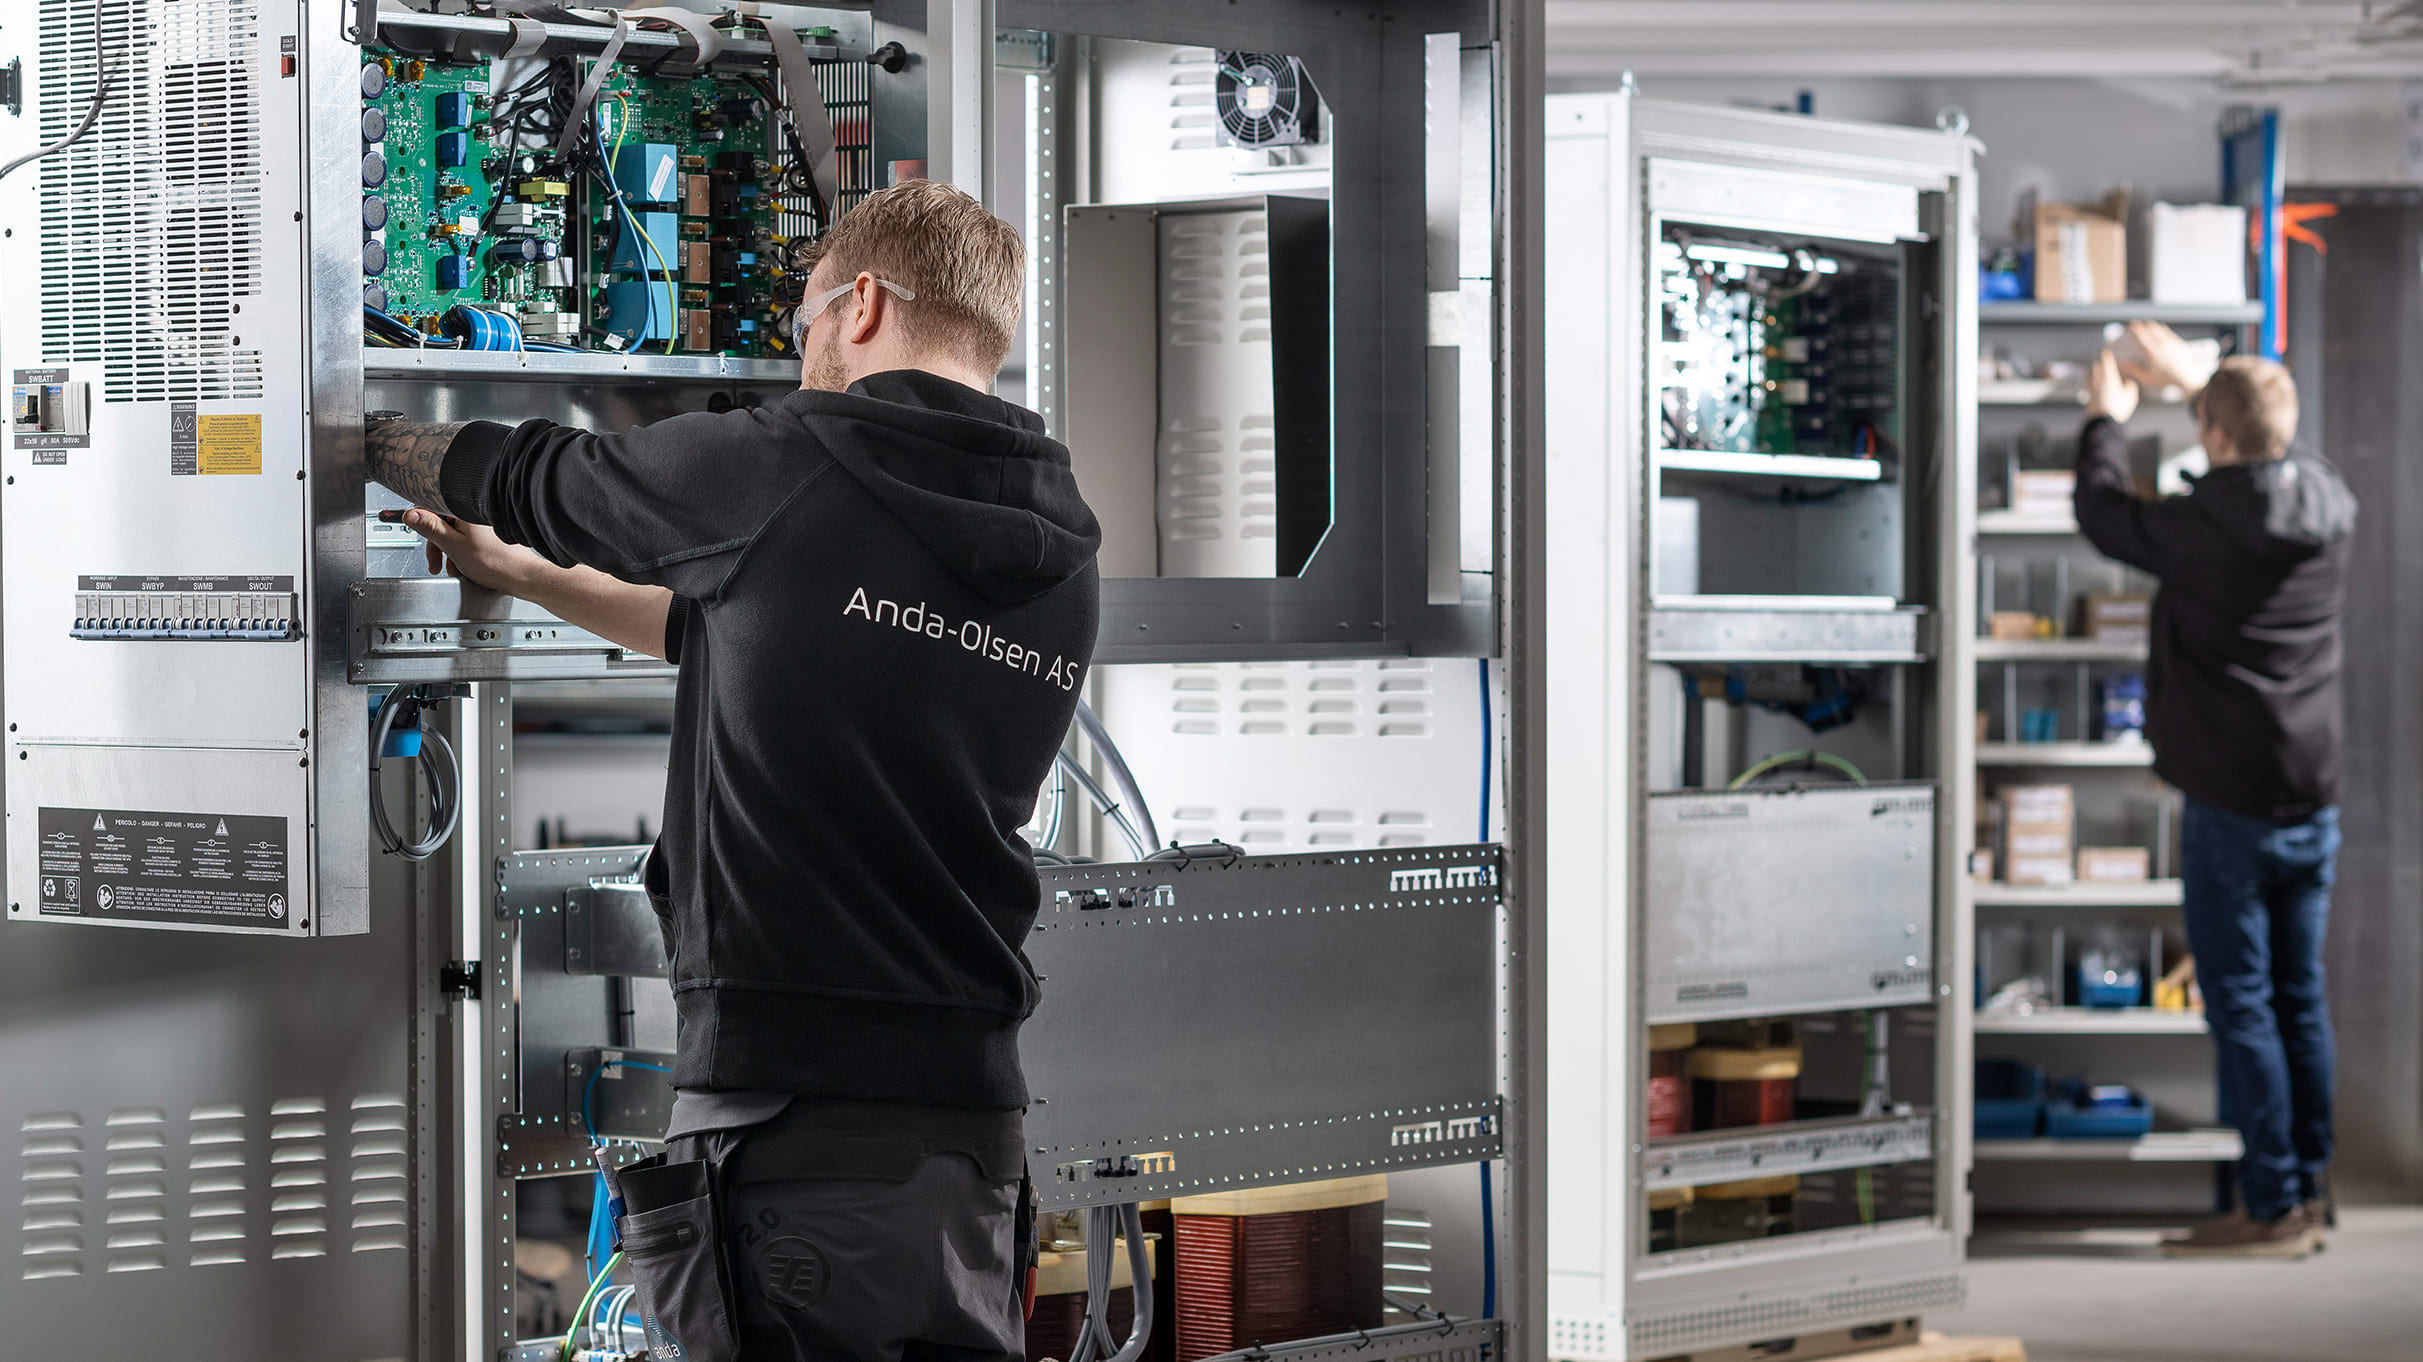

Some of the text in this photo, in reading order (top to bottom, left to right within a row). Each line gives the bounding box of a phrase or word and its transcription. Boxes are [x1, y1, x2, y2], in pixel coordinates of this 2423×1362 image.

[28, 375, 54, 383] SWBATT
[141, 582, 165, 590] SWBYP
[193, 582, 213, 590] SWMB
[843, 587, 1078, 692] Anda-Olsen AS
[738, 1207, 782, 1246] 2.0
[654, 1340, 680, 1360] anda
